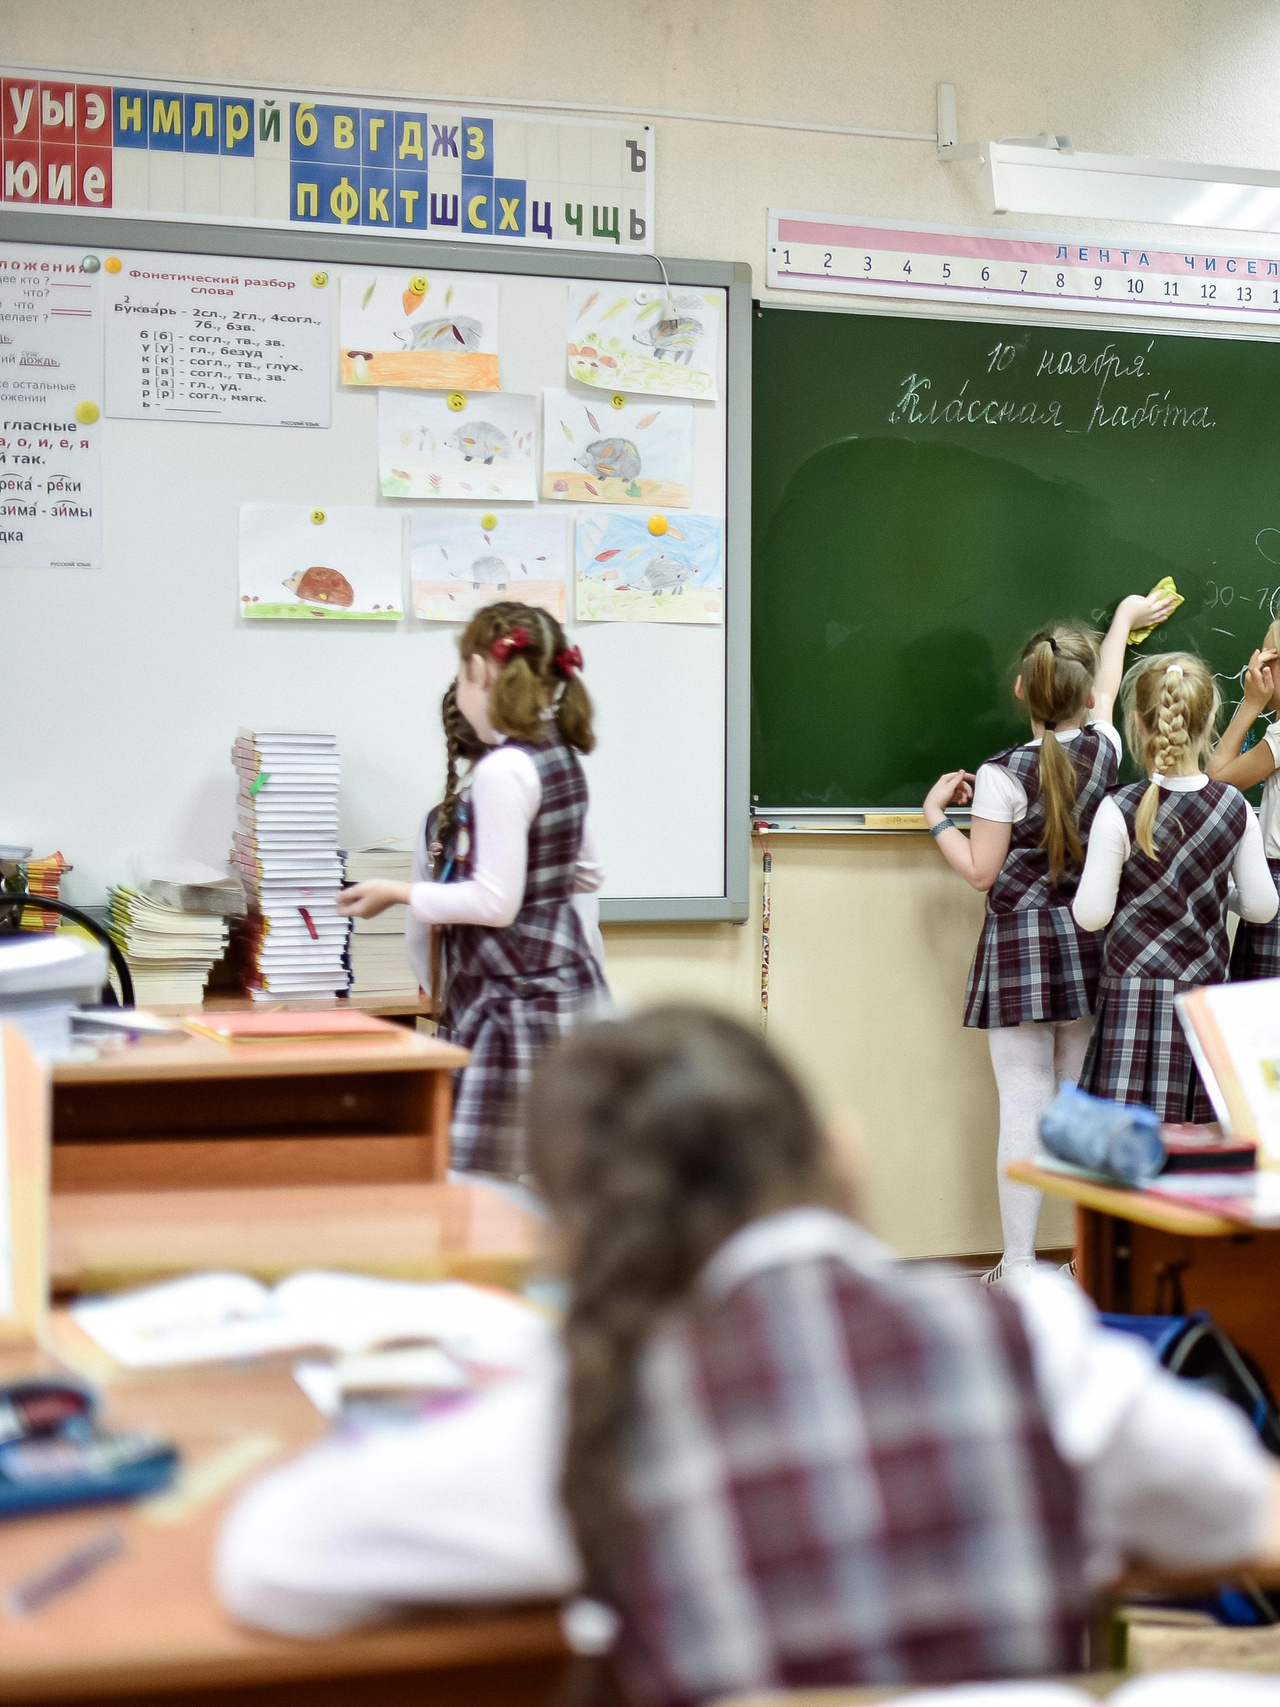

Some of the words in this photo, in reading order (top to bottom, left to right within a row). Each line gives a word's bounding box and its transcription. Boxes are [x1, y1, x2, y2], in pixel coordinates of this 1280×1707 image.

[1056, 246, 1150, 267] ЛЕНТА
[1184, 255, 1279, 276] ЧИСЕЛ
[20, 276, 40, 285] кто
[129, 270, 239, 284] Фонетический
[244, 279, 296, 290] разбор
[783, 250, 792, 265] 1
[823, 253, 833, 268] 2
[863, 256, 873, 272] 3
[902, 260, 912, 275] 4
[942, 263, 951, 278] 5
[981, 267, 990, 282] 6
[1019, 270, 1028, 285] 7
[1056, 273, 1065, 288] 8
[1094, 276, 1103, 291] 9
[1128, 279, 1144, 294] 10
[1164, 282, 1178, 297] 11
[1200, 285, 1216, 300] 12
[1237, 287, 1252, 302] 13
[23, 289, 50, 298] что?
[191, 287, 233, 296] слова
[14, 302, 34, 310] что
[987, 342, 1015, 373] 10
[12, 381, 76, 391] остальные
[3, 420, 77, 432] гласные
[12, 454, 46, 465] так.
